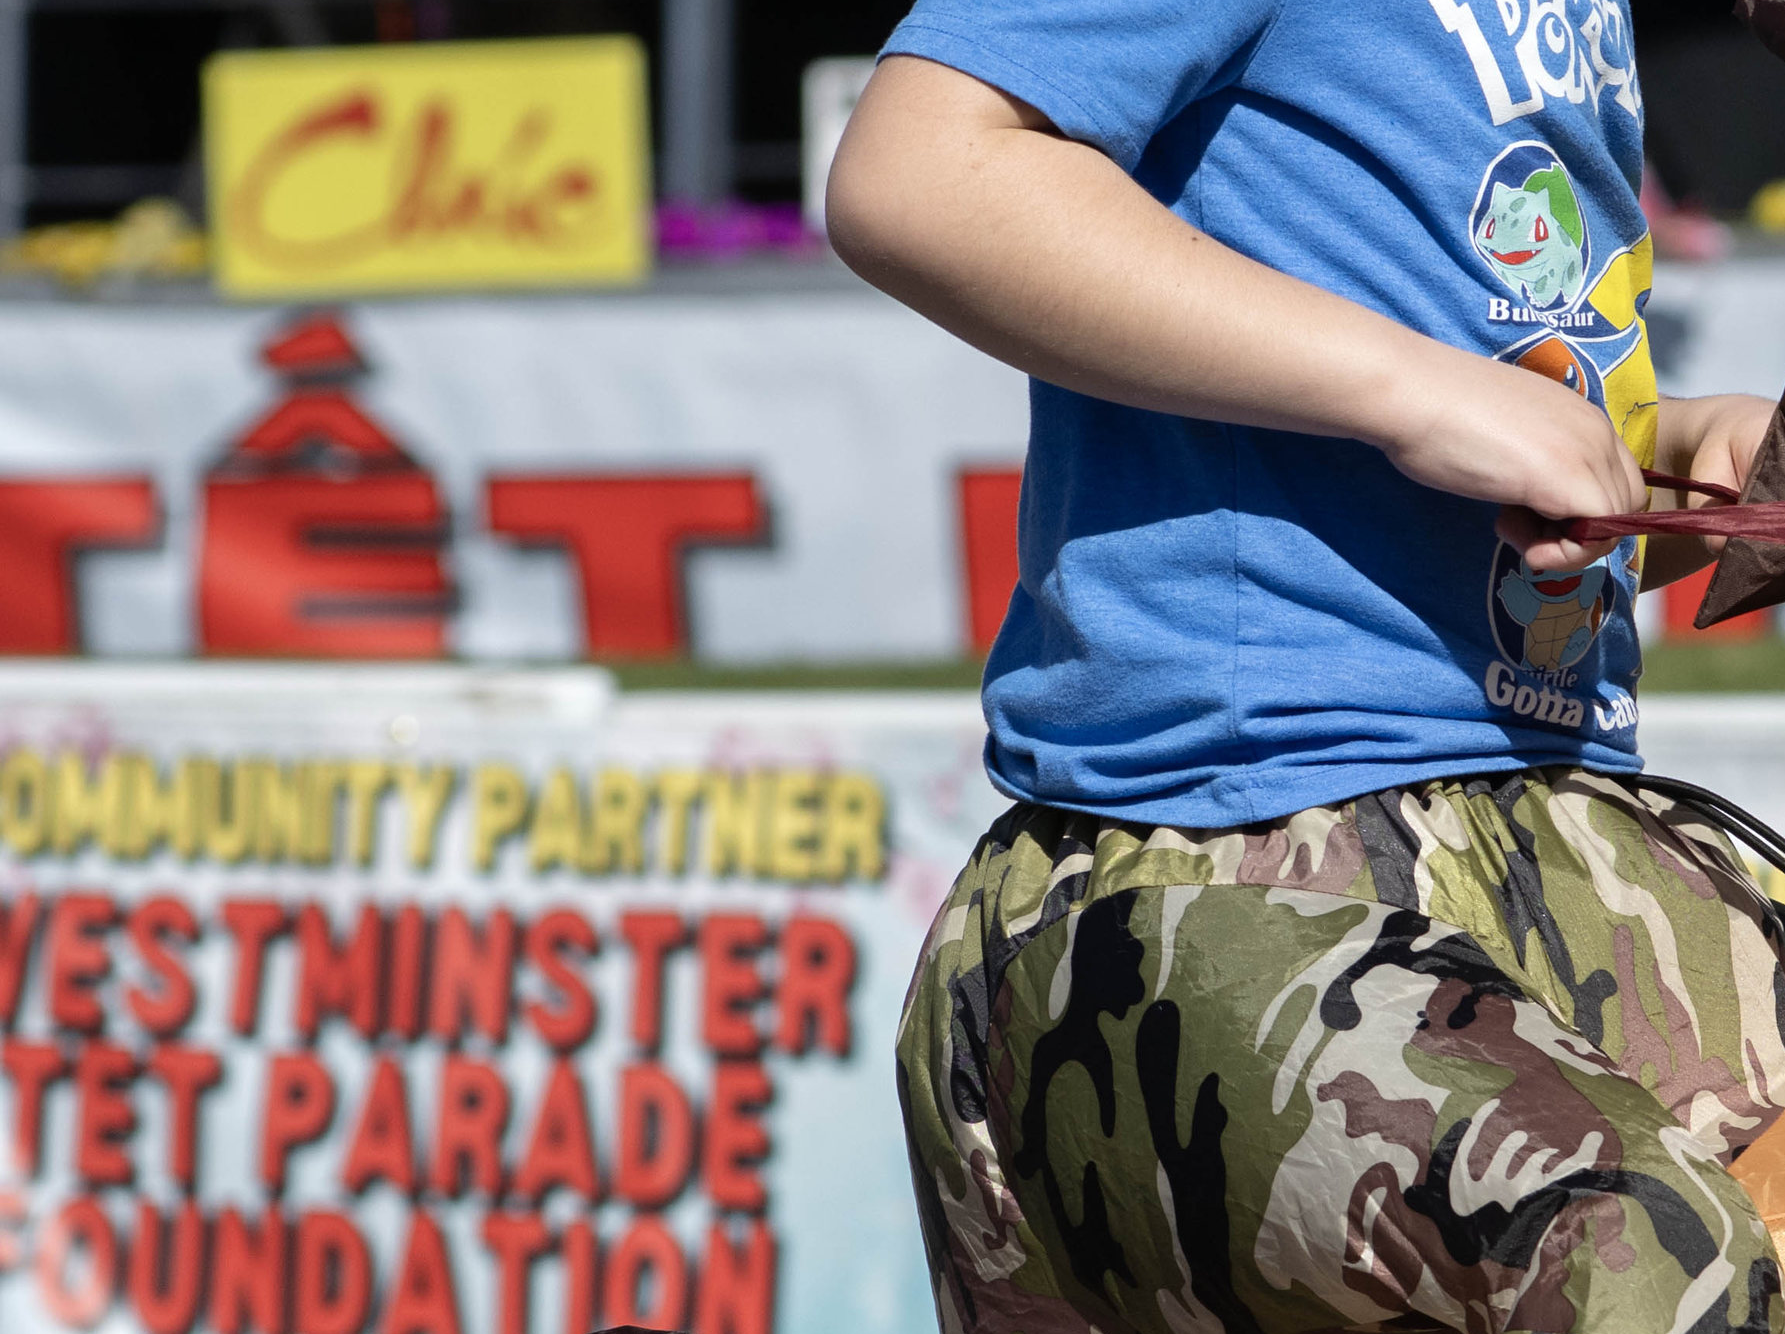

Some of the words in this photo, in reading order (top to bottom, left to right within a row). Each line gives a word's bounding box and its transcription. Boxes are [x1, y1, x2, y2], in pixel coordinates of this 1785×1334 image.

[1485, 660, 1584, 728] Gotta
[474, 763, 888, 880] PARTNER
[2, 1039, 220, 1187] TET
[258, 1049, 771, 1209] PARADE
